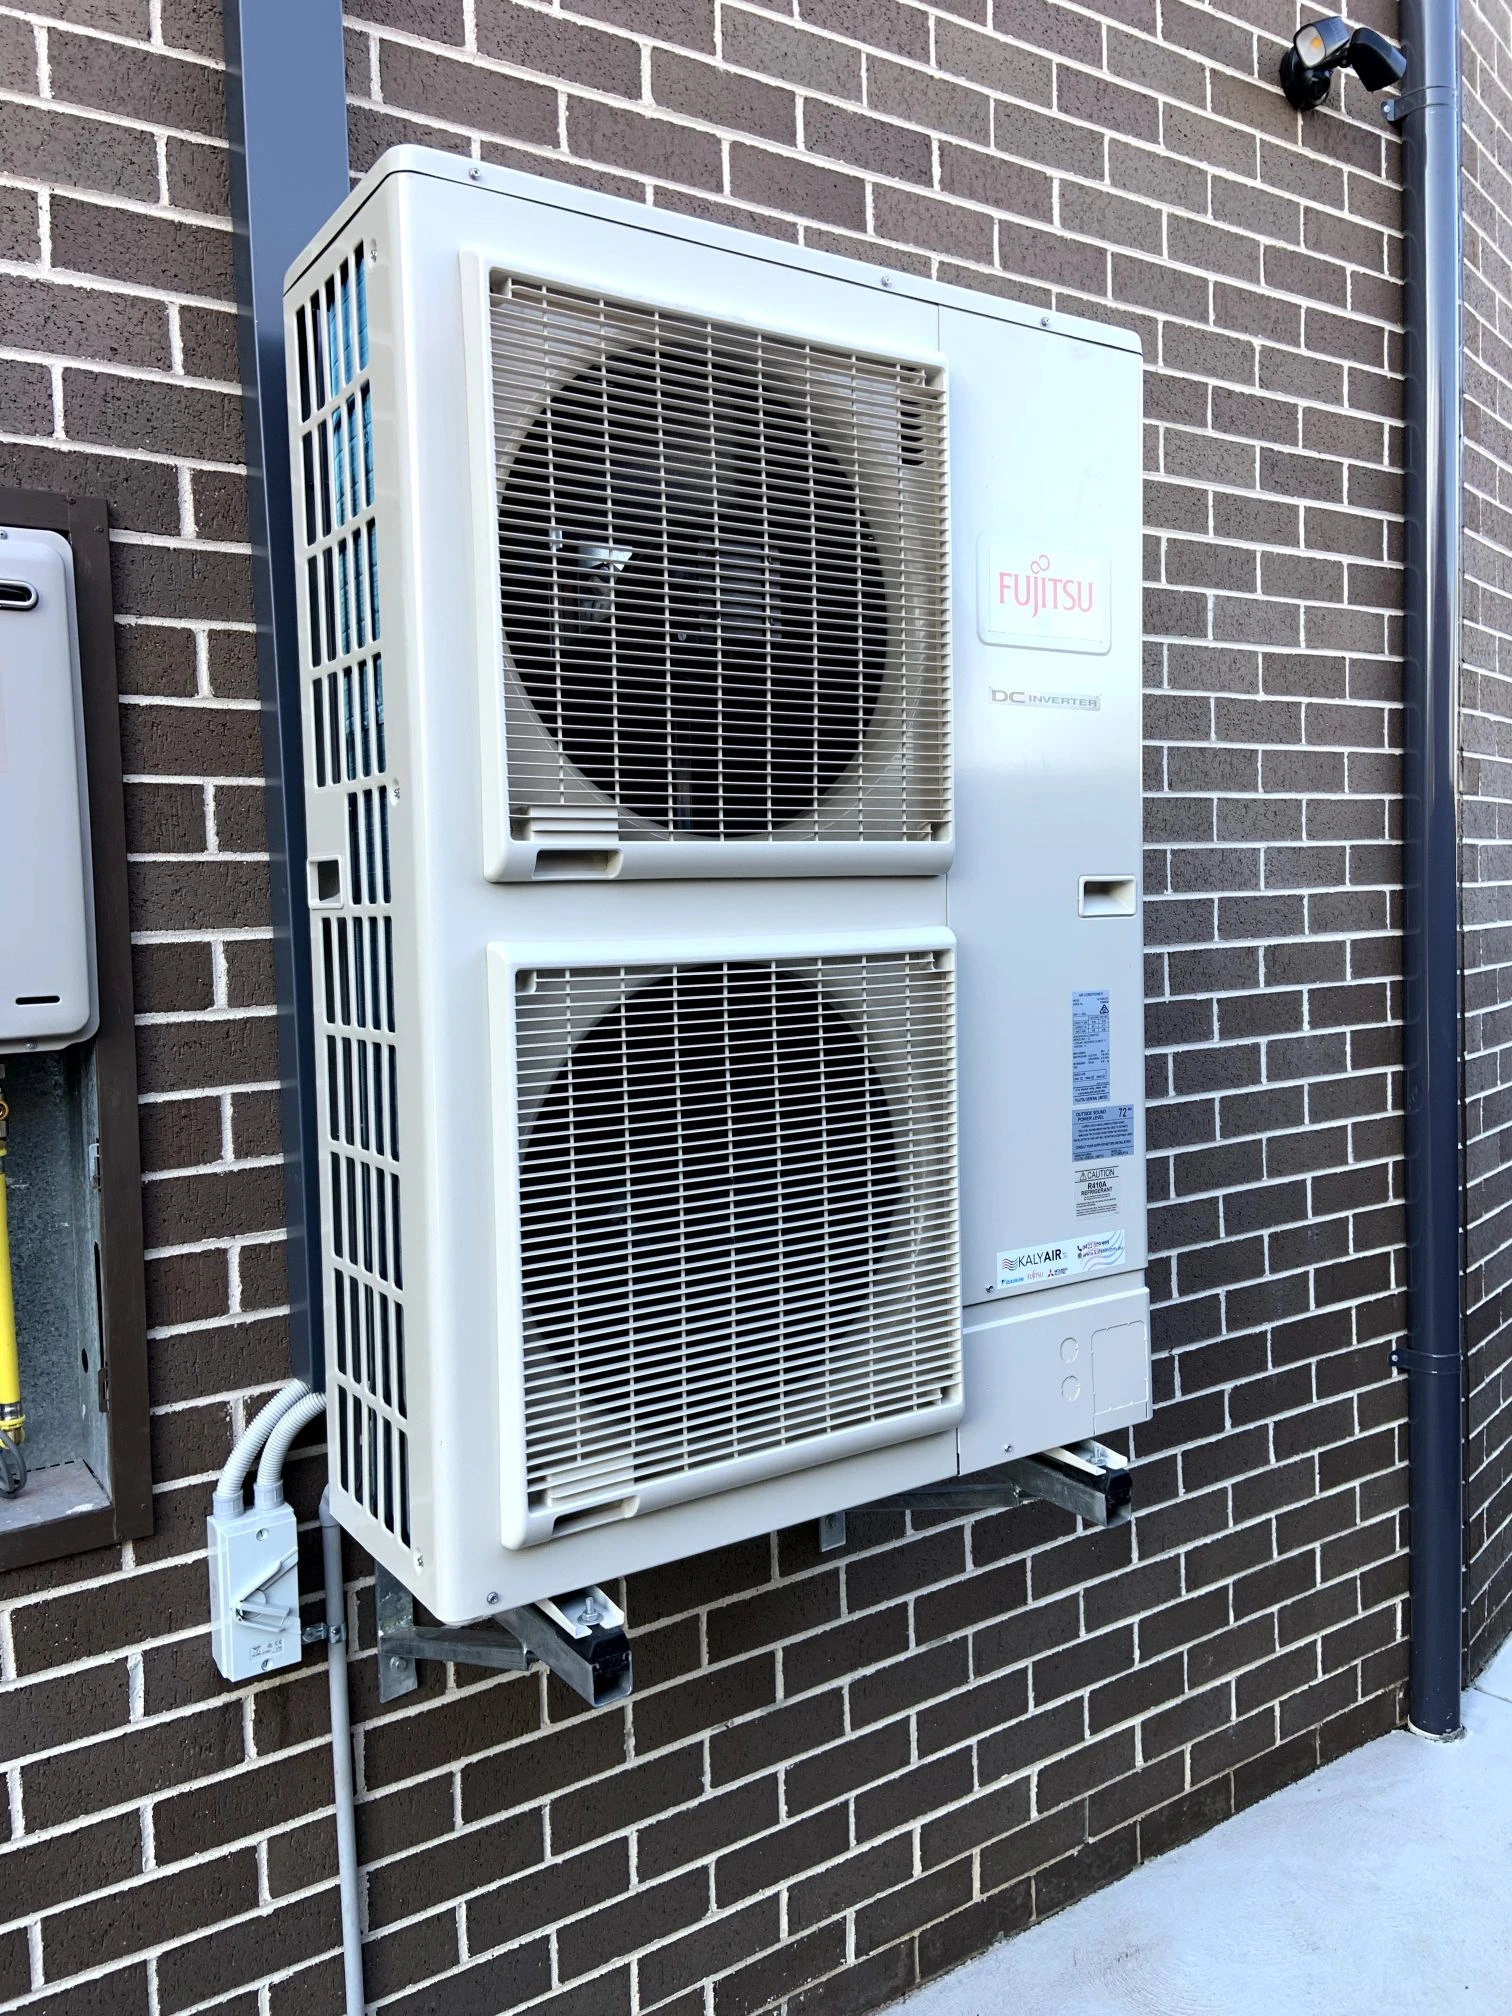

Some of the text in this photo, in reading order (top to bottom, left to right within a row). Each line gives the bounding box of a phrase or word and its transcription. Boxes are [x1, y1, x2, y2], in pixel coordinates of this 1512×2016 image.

[998, 554, 1093, 617] FUJITSU
[991, 690, 1098, 707] DC INVERTER
[1118, 1107, 1127, 1117] 72
[1087, 1168, 1115, 1179] CAUTION
[1087, 1181, 1107, 1190] R410A
[1081, 1187, 1113, 1196] REFRIGERANT
[1018, 1248, 1062, 1267] KALYAIR
